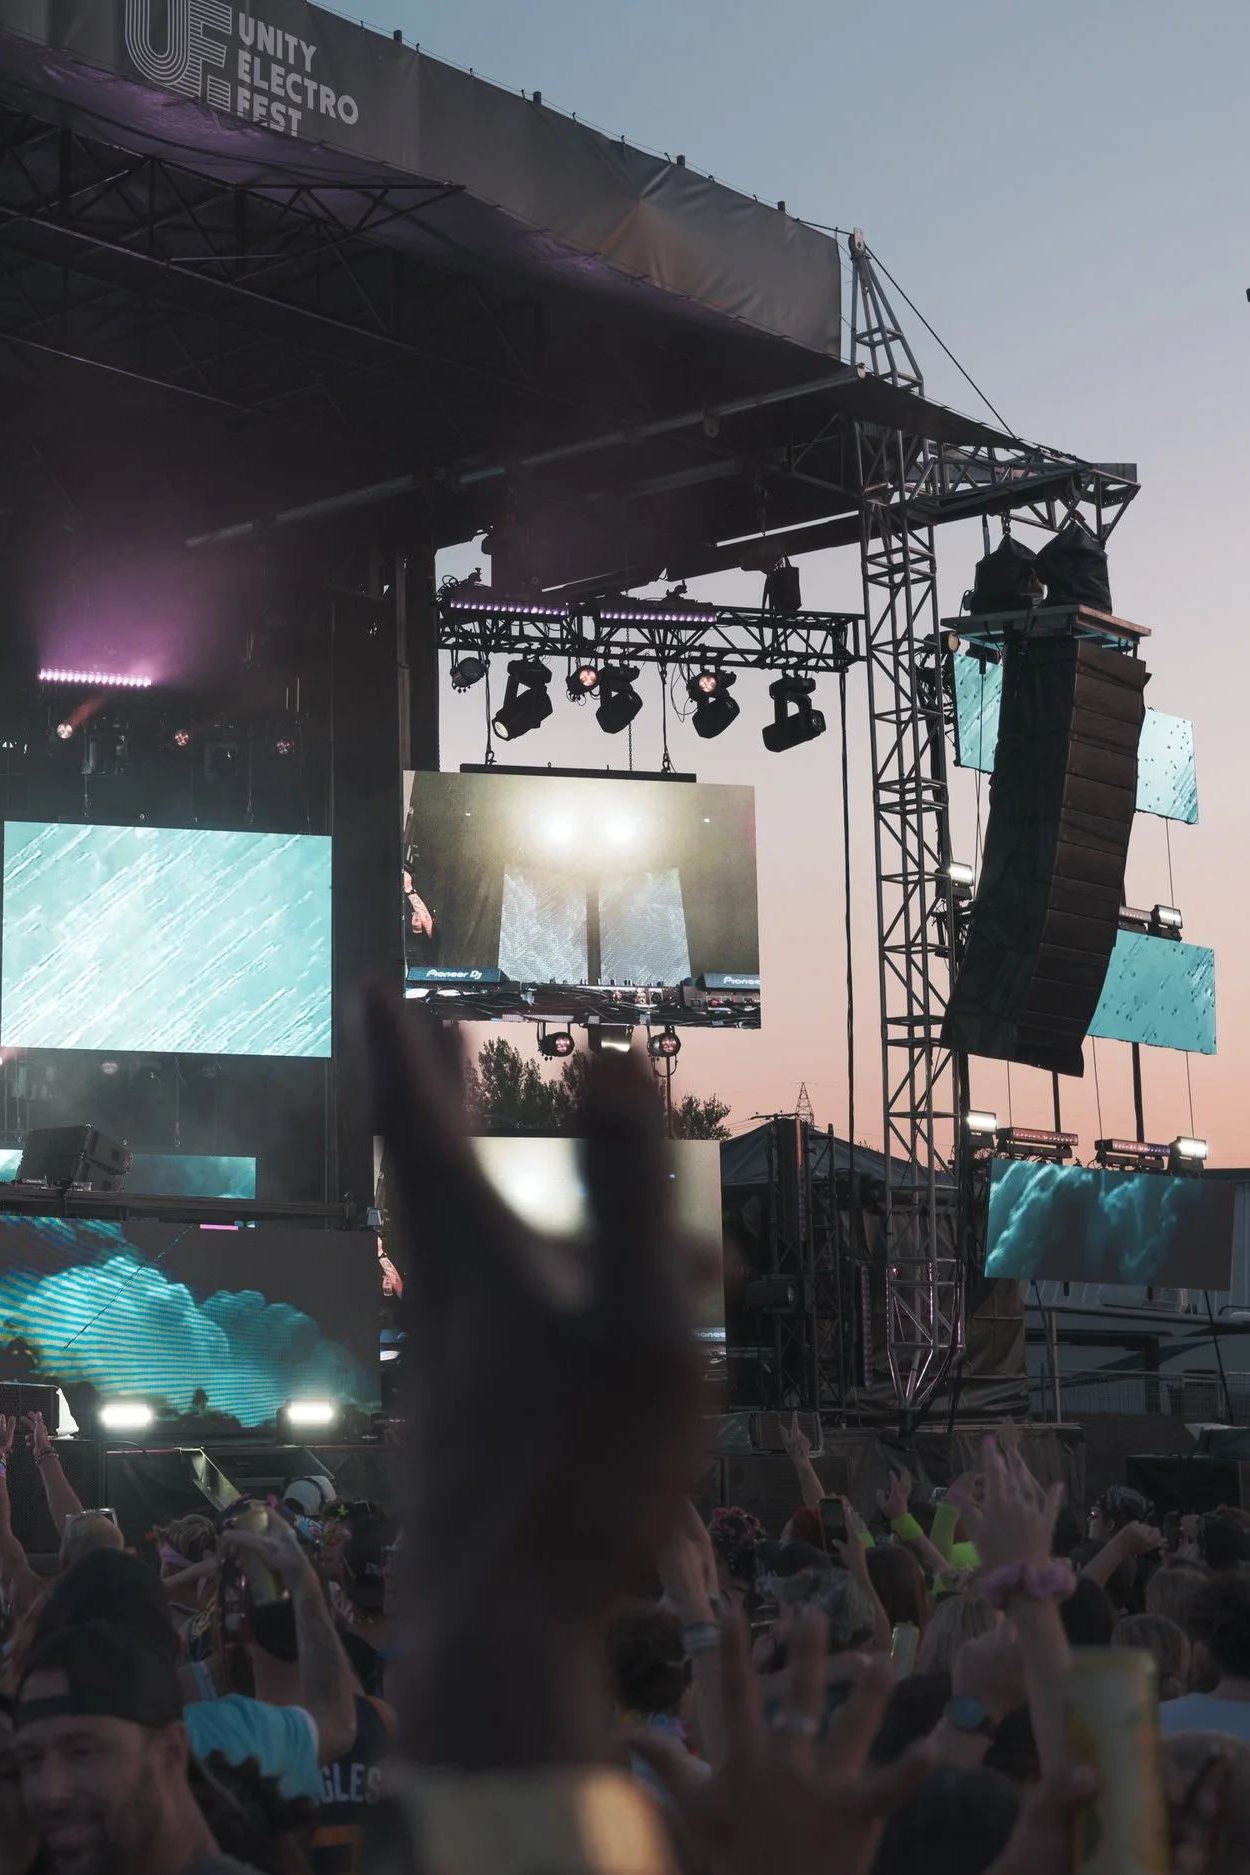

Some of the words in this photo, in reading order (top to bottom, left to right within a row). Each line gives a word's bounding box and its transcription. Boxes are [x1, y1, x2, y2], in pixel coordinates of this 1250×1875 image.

[238, 11, 317, 73] UNITY
[236, 85, 302, 138] FEST
[237, 48, 359, 125] ELECTRO
[426, 968, 469, 978] Pioneer
[315, 1762, 382, 1806] GLES
